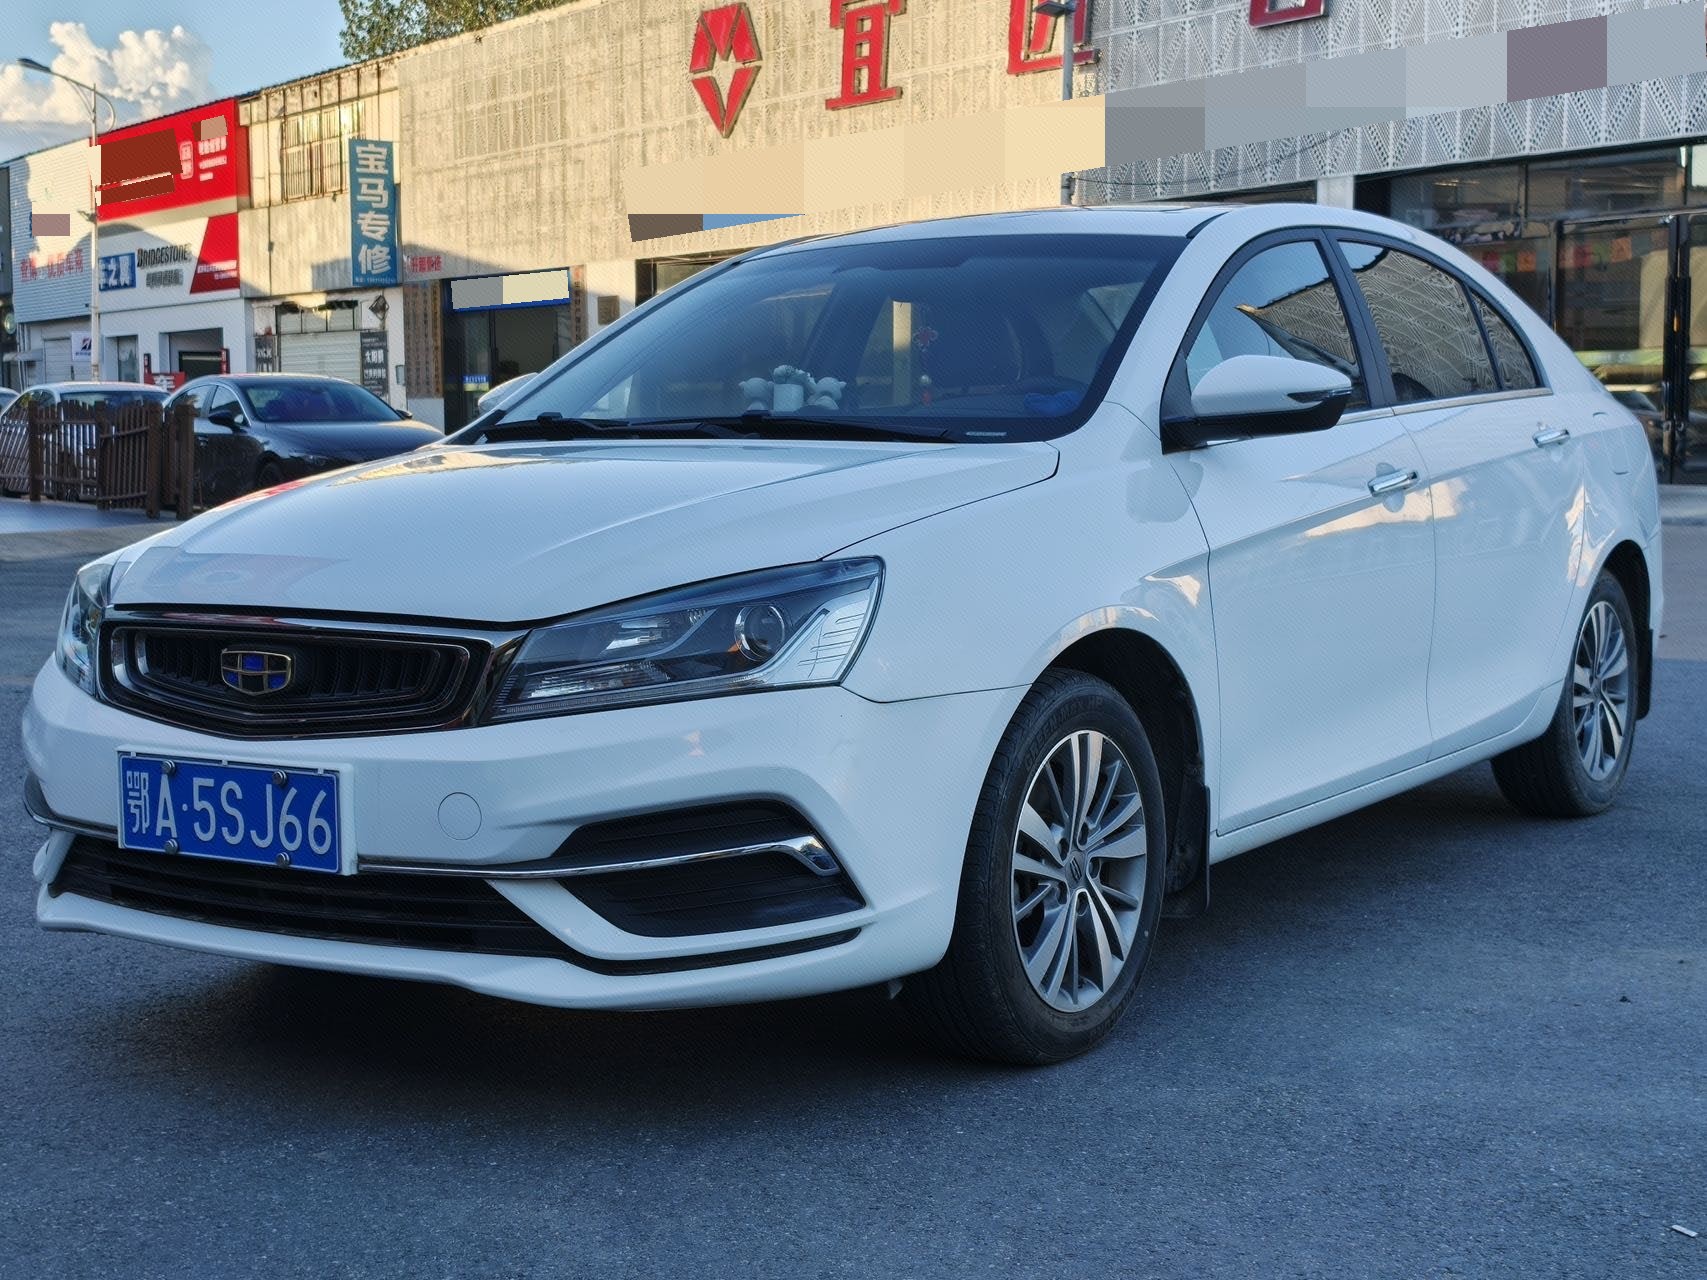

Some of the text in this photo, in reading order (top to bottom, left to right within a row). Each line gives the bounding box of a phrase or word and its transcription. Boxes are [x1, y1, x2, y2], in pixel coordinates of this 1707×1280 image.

[355, 143, 391, 275] 宝马专修
[137, 244, 191, 268] BRIDGESTONE
[126, 770, 333, 855] 鄂A·5SJ66
